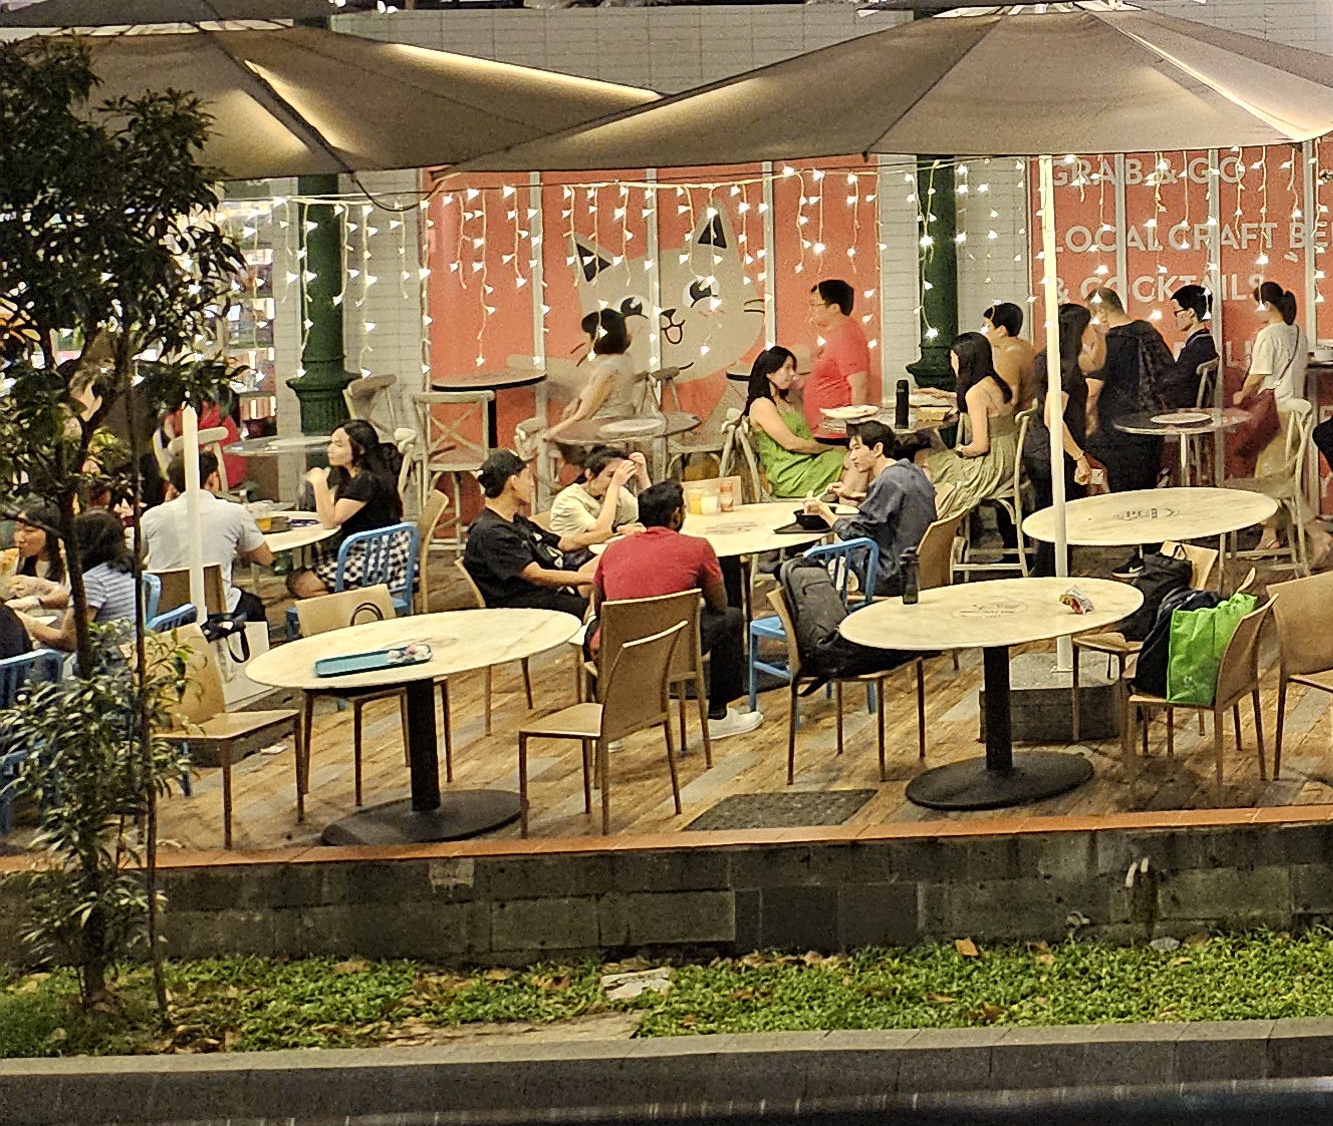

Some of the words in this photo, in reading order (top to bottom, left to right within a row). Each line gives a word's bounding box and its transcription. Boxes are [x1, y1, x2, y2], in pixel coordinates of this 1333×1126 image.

[1052, 158, 1143, 186] GRAB
[1188, 156, 1246, 184] GO
[1055, 223, 1163, 253] OCAL
[1168, 221, 1278, 251] CRAFT
